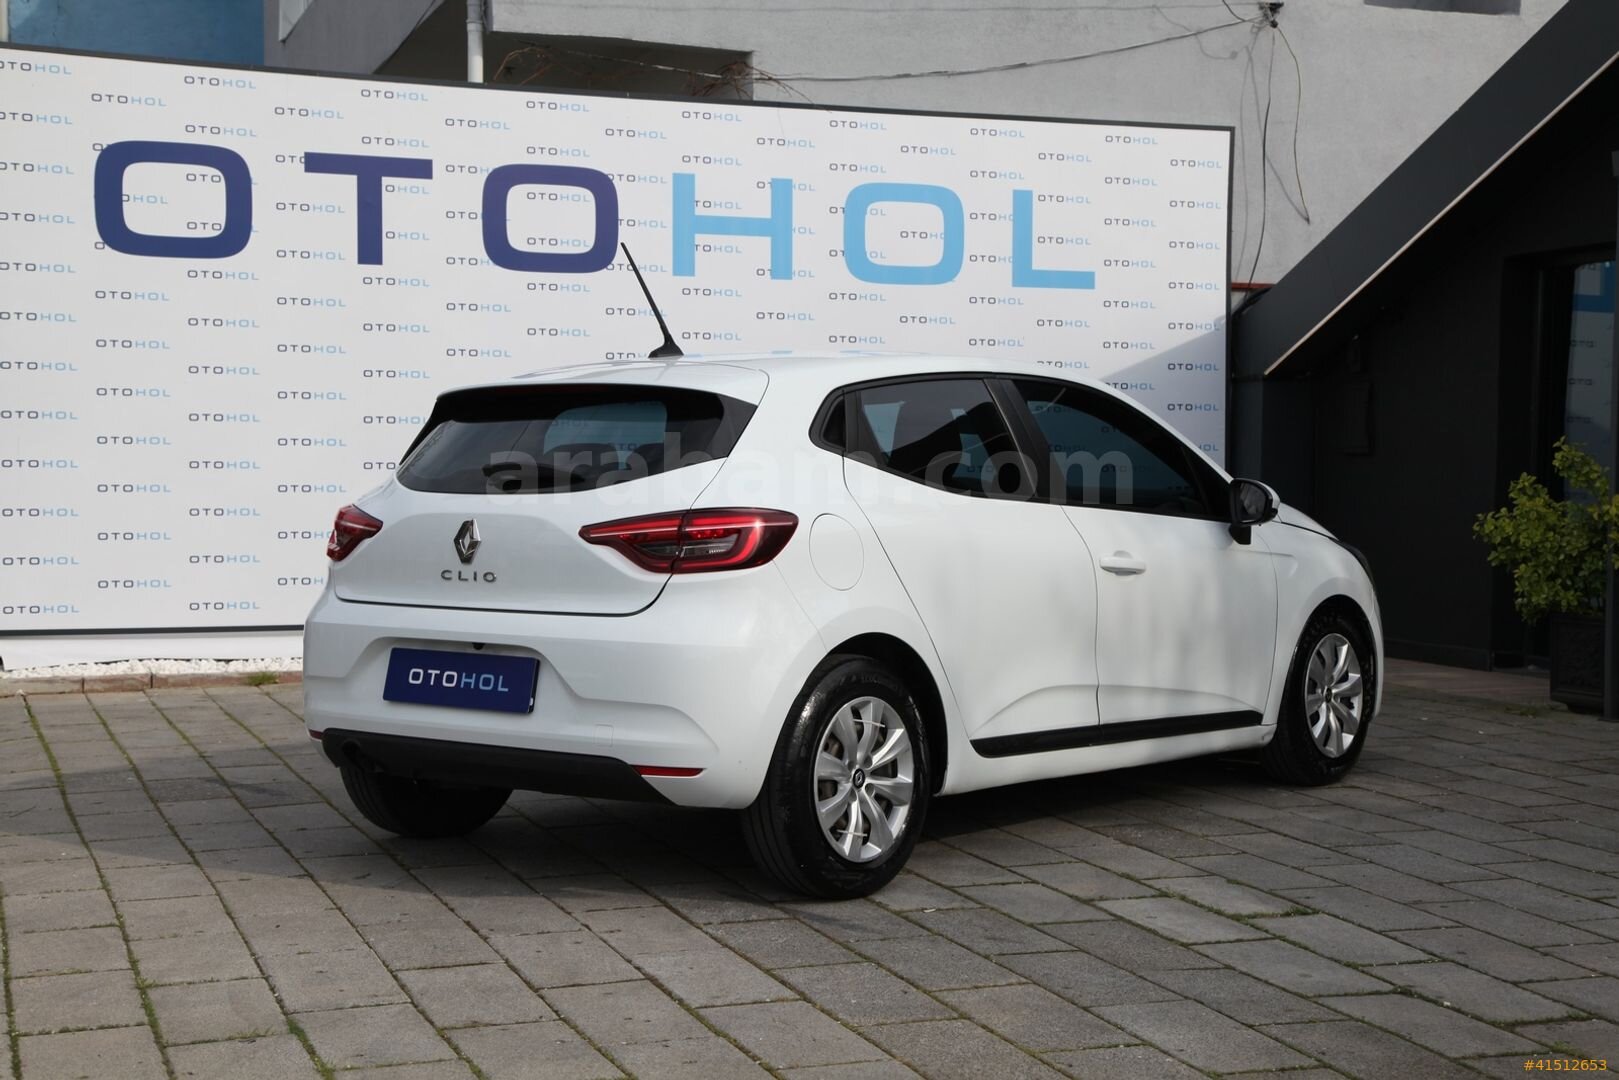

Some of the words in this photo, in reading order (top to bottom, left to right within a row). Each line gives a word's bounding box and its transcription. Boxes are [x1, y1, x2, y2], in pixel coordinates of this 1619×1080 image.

[184, 76, 256, 89] OTOHOL
[91, 93, 166, 106] OTOHOL
[361, 89, 428, 102] OTOHOL
[526, 101, 589, 112] OTOHOL
[274, 107, 345, 119] OTOHOL
[682, 111, 741, 122] OTOHOL
[445, 118, 510, 130] OTOHOL
[829, 120, 886, 130] OTOHOL
[185, 125, 257, 137] OTOHOL
[605, 128, 667, 139] OTOHOL
[970, 128, 1025, 137] OTOHOL
[361, 136, 429, 147] OTOHOL
[757, 137, 815, 147] OTOHOL
[1105, 135, 1158, 144] OTOHOL
[527, 146, 590, 157] OTOHOL
[900, 145, 956, 155] OTOHOL
[682, 155, 742, 166] OTOHOL
[1038, 153, 1091, 162] OTOHOL
[1170, 159, 1222, 168] OTOHOL
[445, 164, 489, 174] OTOH
[829, 163, 886, 174] OTOHOL
[970, 170, 1024, 179] OTOHOL
[1104, 177, 1157, 186] OTOHOL
[385, 184, 430, 194] OHOL
[122, 194, 168, 205] OHOL
[527, 192, 590, 202] OTOHOL
[1038, 194, 1091, 204] OTOHOL
[276, 202, 345, 213] OTOHOL
[695, 200, 742, 209] TOHOL
[1169, 200, 1221, 209] OTOHOL
[94, 140, 1096, 290] OTOHOL
[446, 211, 478, 219] OTO
[619, 219, 667, 228] TOHOL
[1104, 218, 1156, 227] OTOHOL
[386, 231, 431, 241] OHOL
[1037, 236, 1091, 245] OTOHOL
[527, 237, 590, 247] OTOHOL
[1169, 241, 1220, 249] OTOHOL
[695, 244, 742, 253] TOHOL
[276, 250, 345, 261] OTOHOL
[446, 256, 490, 265] OTOH
[1104, 259, 1156, 268] OTOHOL
[187, 270, 259, 281] OTOHOL
[363, 277, 430, 287] OTOHOL
[1168, 281, 1220, 290] OTOHOL
[527, 283, 590, 292] OTOHOL
[95, 290, 169, 301] OTOHOL
[682, 288, 742, 297] OTOHOL
[829, 292, 886, 301] OTOHOL
[277, 297, 346, 307] OTOHOL
[969, 297, 1024, 306] OTOHOL
[1103, 300, 1155, 308] OTOHOL
[446, 303, 511, 312] OTOHOL
[756, 312, 815, 321] OTOHOL
[899, 316, 955, 324] OTOHOL
[188, 318, 259, 328] OTOHOL
[1037, 319, 1090, 327] OTOHOL
[1168, 322, 1219, 331] OTOHOL
[363, 323, 430, 333] OTOHOL
[527, 328, 590, 337] OTOHOL
[682, 332, 742, 341] OTOHOL
[829, 335, 885, 344] OTOHOL
[96, 339, 170, 349] OTOHOL
[969, 338, 1023, 347] OTOHOL
[1103, 341, 1155, 349] OTOHOL
[277, 344, 346, 353] OTOHOL
[446, 348, 511, 357] OTOHOL
[0, 361, 77, 371] OTOHOL
[188, 366, 260, 375] OTOHOL
[1167, 363, 1219, 371] OTOHOL
[363, 370, 430, 379] OTOHOL
[96, 388, 170, 397] OTOHOL
[277, 391, 347, 400] OTOHOL
[1167, 403, 1219, 411] OTOHOL
[0, 410, 77, 419] OTOHOL
[189, 413, 260, 422] OTOHOL
[97, 436, 170, 445] OTOHOL
[278, 438, 347, 447] OTOHOL
[1, 459, 78, 468] OTOHOL
[189, 461, 260, 469] OTOHOL
[363, 462, 396, 470] OTO
[97, 484, 171, 493] OTOHOL
[278, 485, 347, 494] OTOHOL
[1, 508, 79, 517] OTOHOL
[189, 508, 261, 517] OTOHOL
[97, 532, 171, 541] OTOHOL
[278, 531, 331, 539] OTOH
[2, 557, 79, 566] OTOHOL
[189, 555, 260, 564] OTOHOL
[441, 569, 497, 583] CLIO
[98, 580, 171, 589] OTOHOL
[278, 577, 323, 585] OTOH
[2, 605, 79, 614] OTOHOL
[189, 602, 260, 611] OTOHOL
[408, 668, 509, 692] OTOHOL
